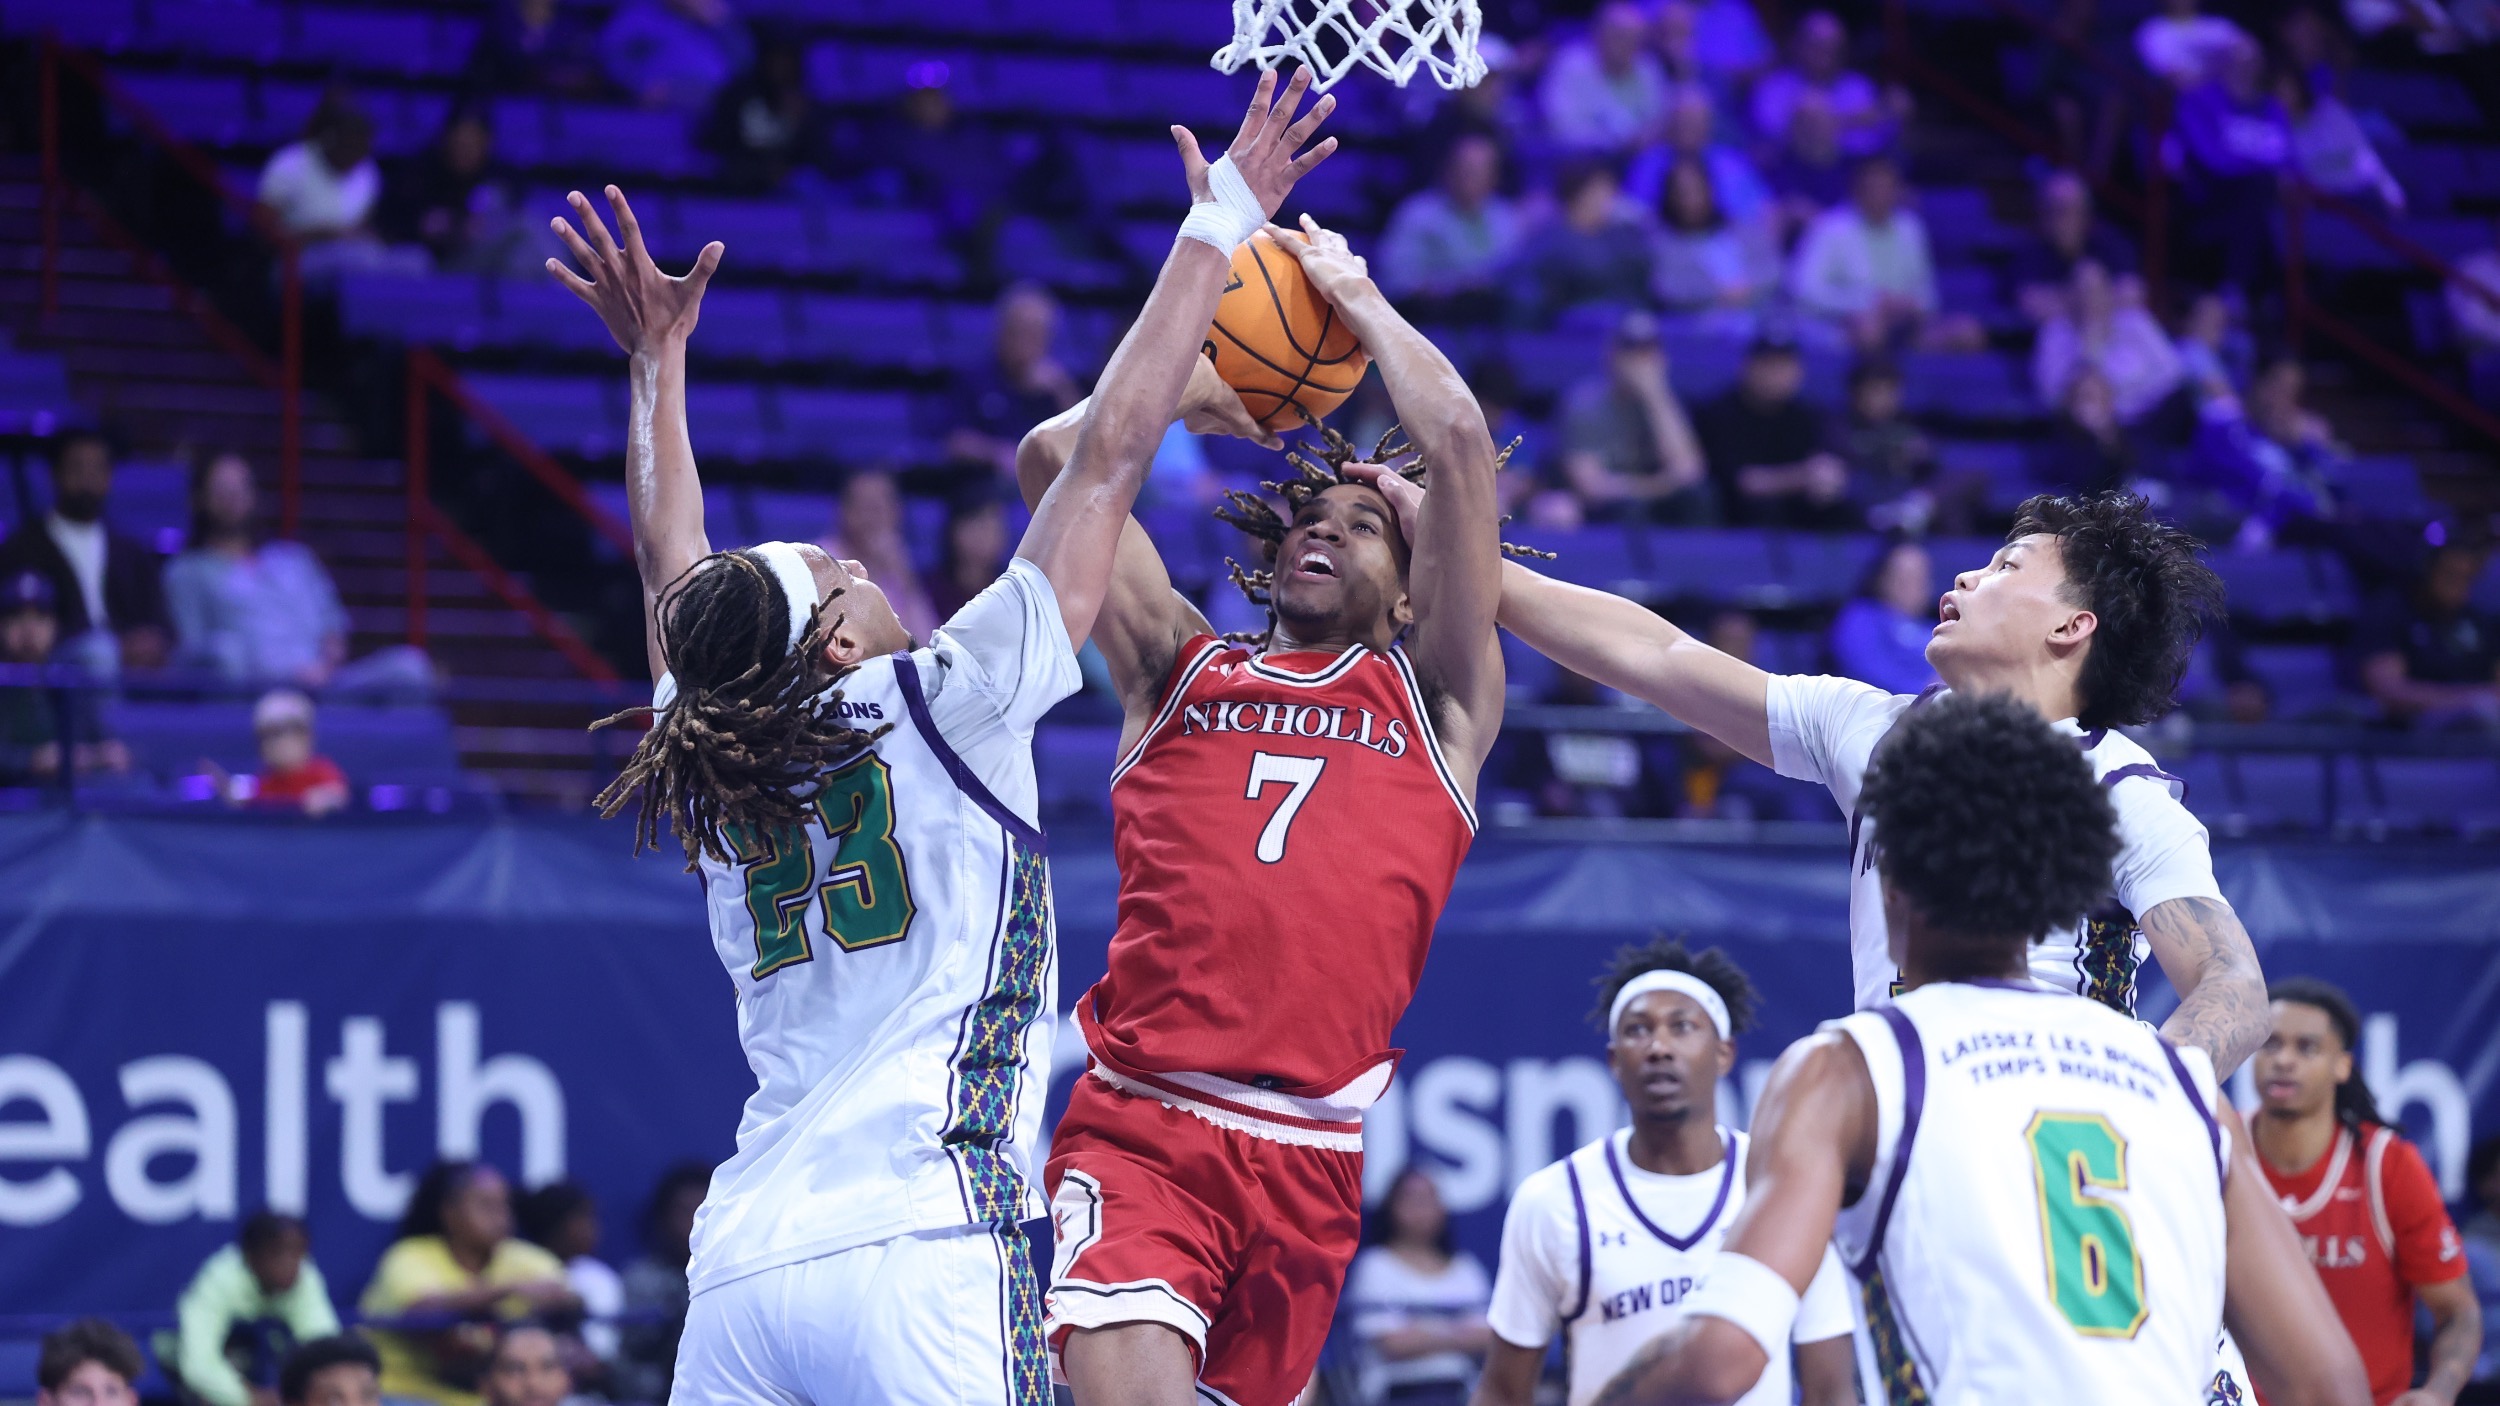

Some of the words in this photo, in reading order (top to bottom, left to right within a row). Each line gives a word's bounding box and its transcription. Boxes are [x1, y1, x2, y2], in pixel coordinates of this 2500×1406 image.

[1182, 701, 1409, 759] NICHOLLS
[1243, 750, 1328, 865] 7
[720, 749, 917, 982] 23
[1940, 1031, 2035, 1066] LAISSEZ
[2048, 1032, 2093, 1057] LES
[1970, 1056, 2046, 1085] TEMPS
[2022, 1109, 2150, 1341] 6
[1601, 1283, 1652, 1324] NEW
